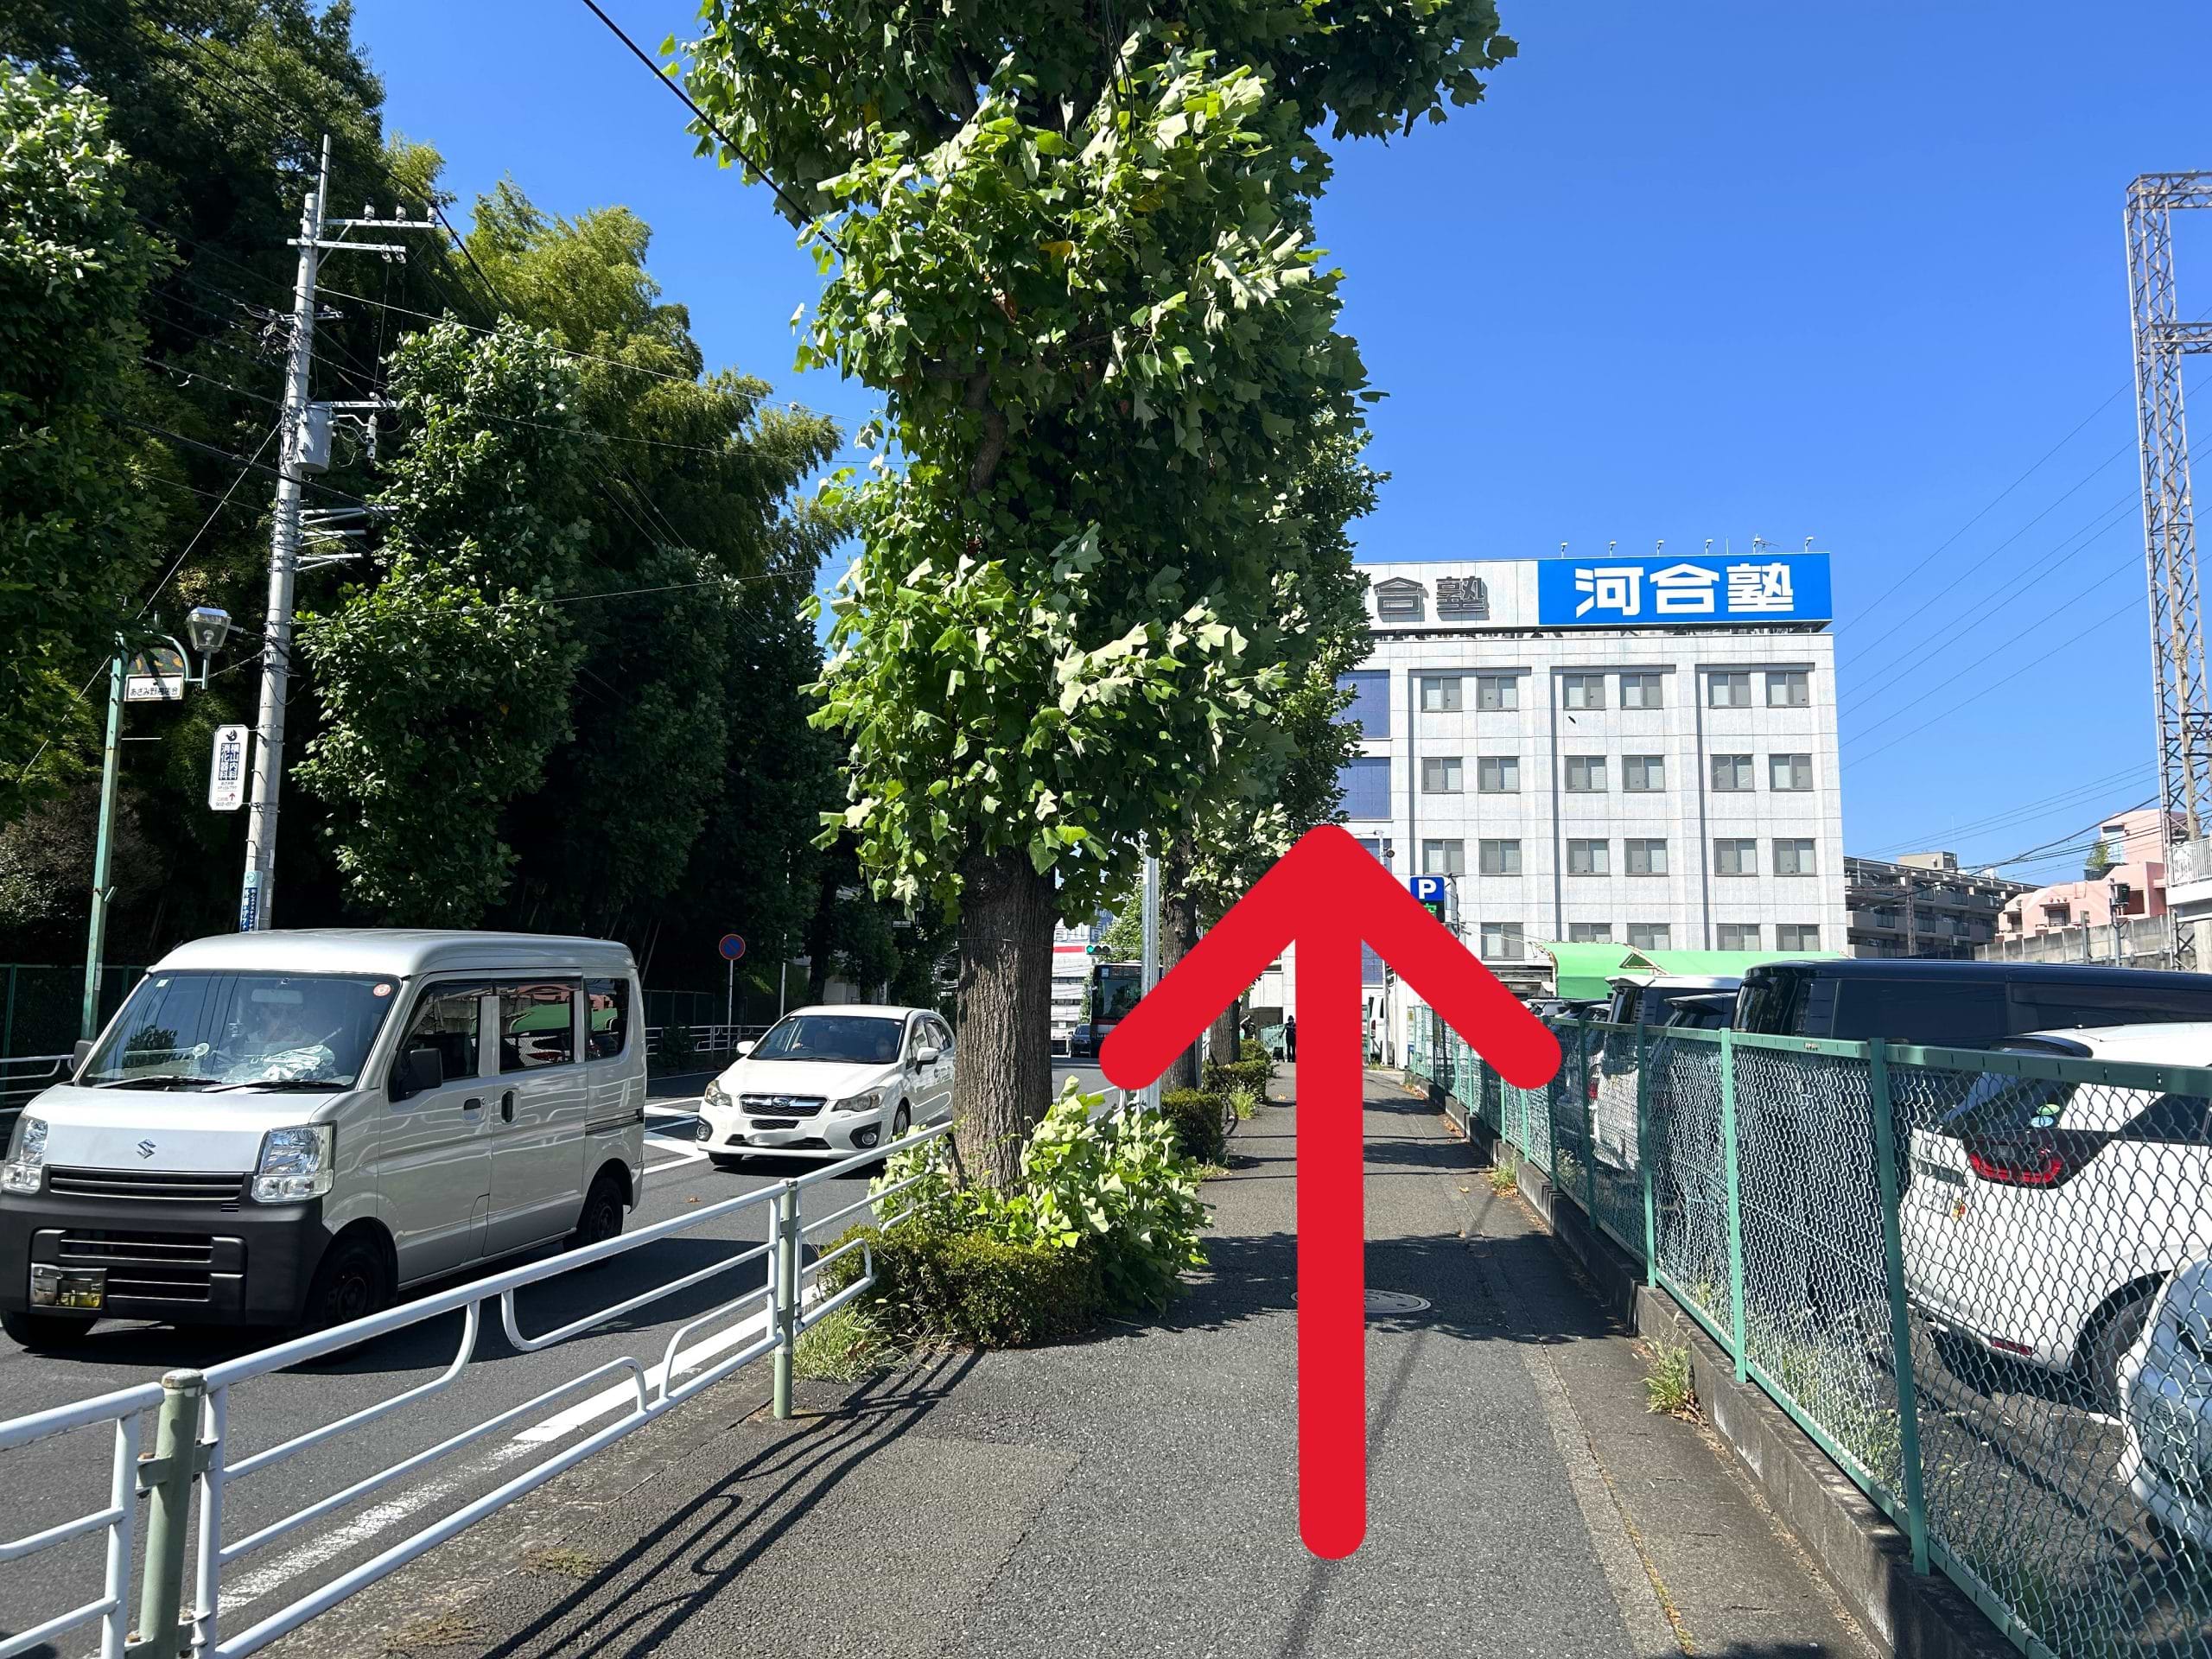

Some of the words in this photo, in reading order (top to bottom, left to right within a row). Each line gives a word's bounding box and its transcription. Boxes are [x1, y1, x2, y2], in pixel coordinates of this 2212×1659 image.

[1363, 575, 1485, 613] 合塾
[1574, 563, 1795, 618] 河合塾
[1418, 879, 1437, 899] P
